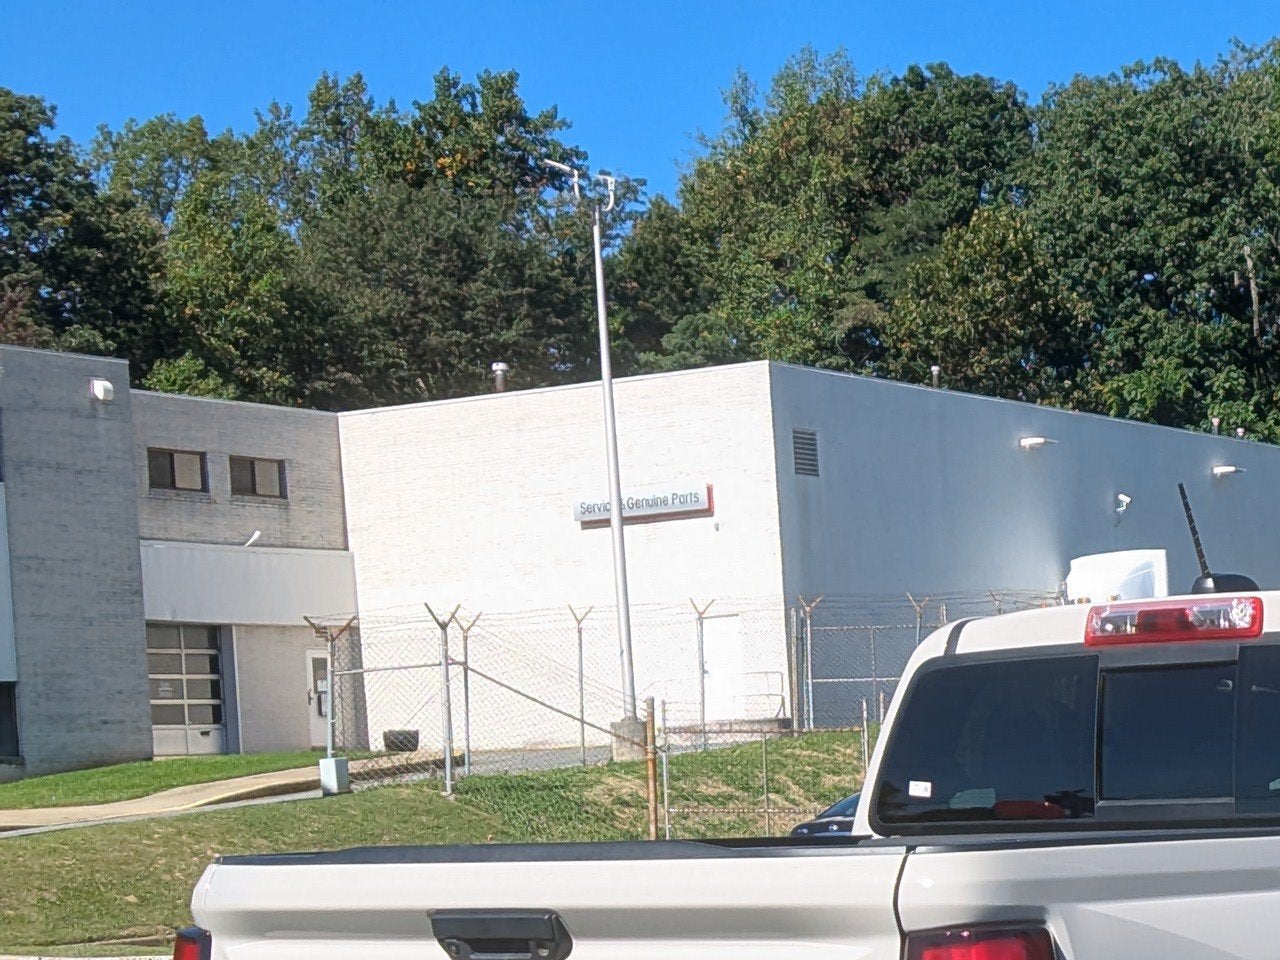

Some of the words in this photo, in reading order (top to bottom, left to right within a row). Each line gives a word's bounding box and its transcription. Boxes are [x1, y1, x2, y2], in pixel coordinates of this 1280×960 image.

[580, 499, 612, 515] Servic
[627, 494, 669, 510] Genuine
[671, 491, 700, 505] Parts
